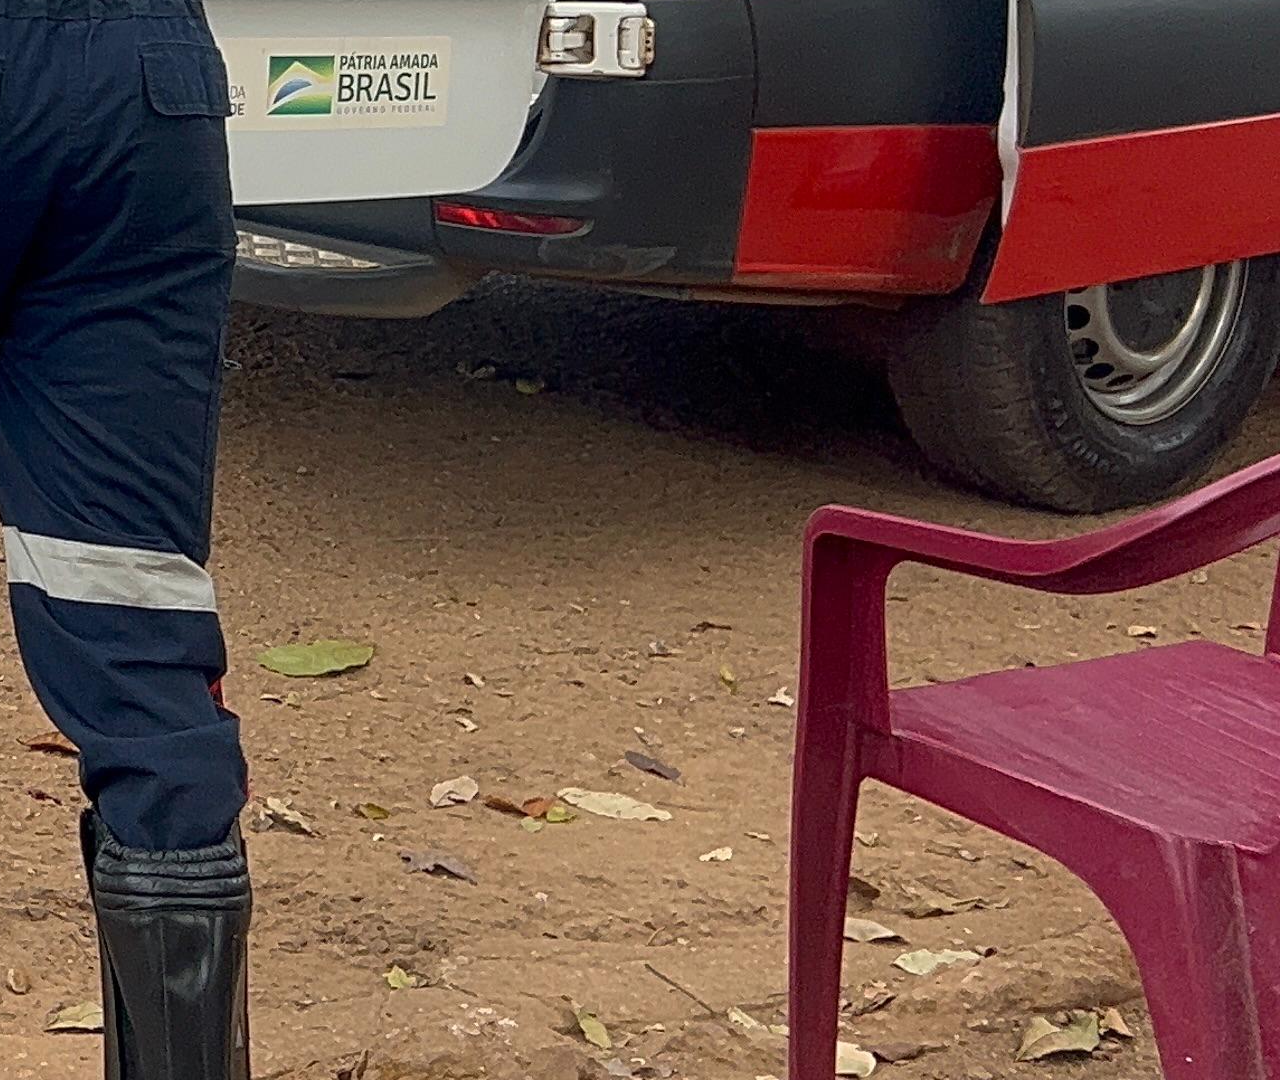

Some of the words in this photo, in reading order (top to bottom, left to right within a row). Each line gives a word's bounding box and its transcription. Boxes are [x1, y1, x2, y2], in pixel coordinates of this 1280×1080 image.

[340, 51, 386, 70] PÁTRIA
[389, 54, 438, 69] AMADA
[337, 72, 436, 102] BRASIL
